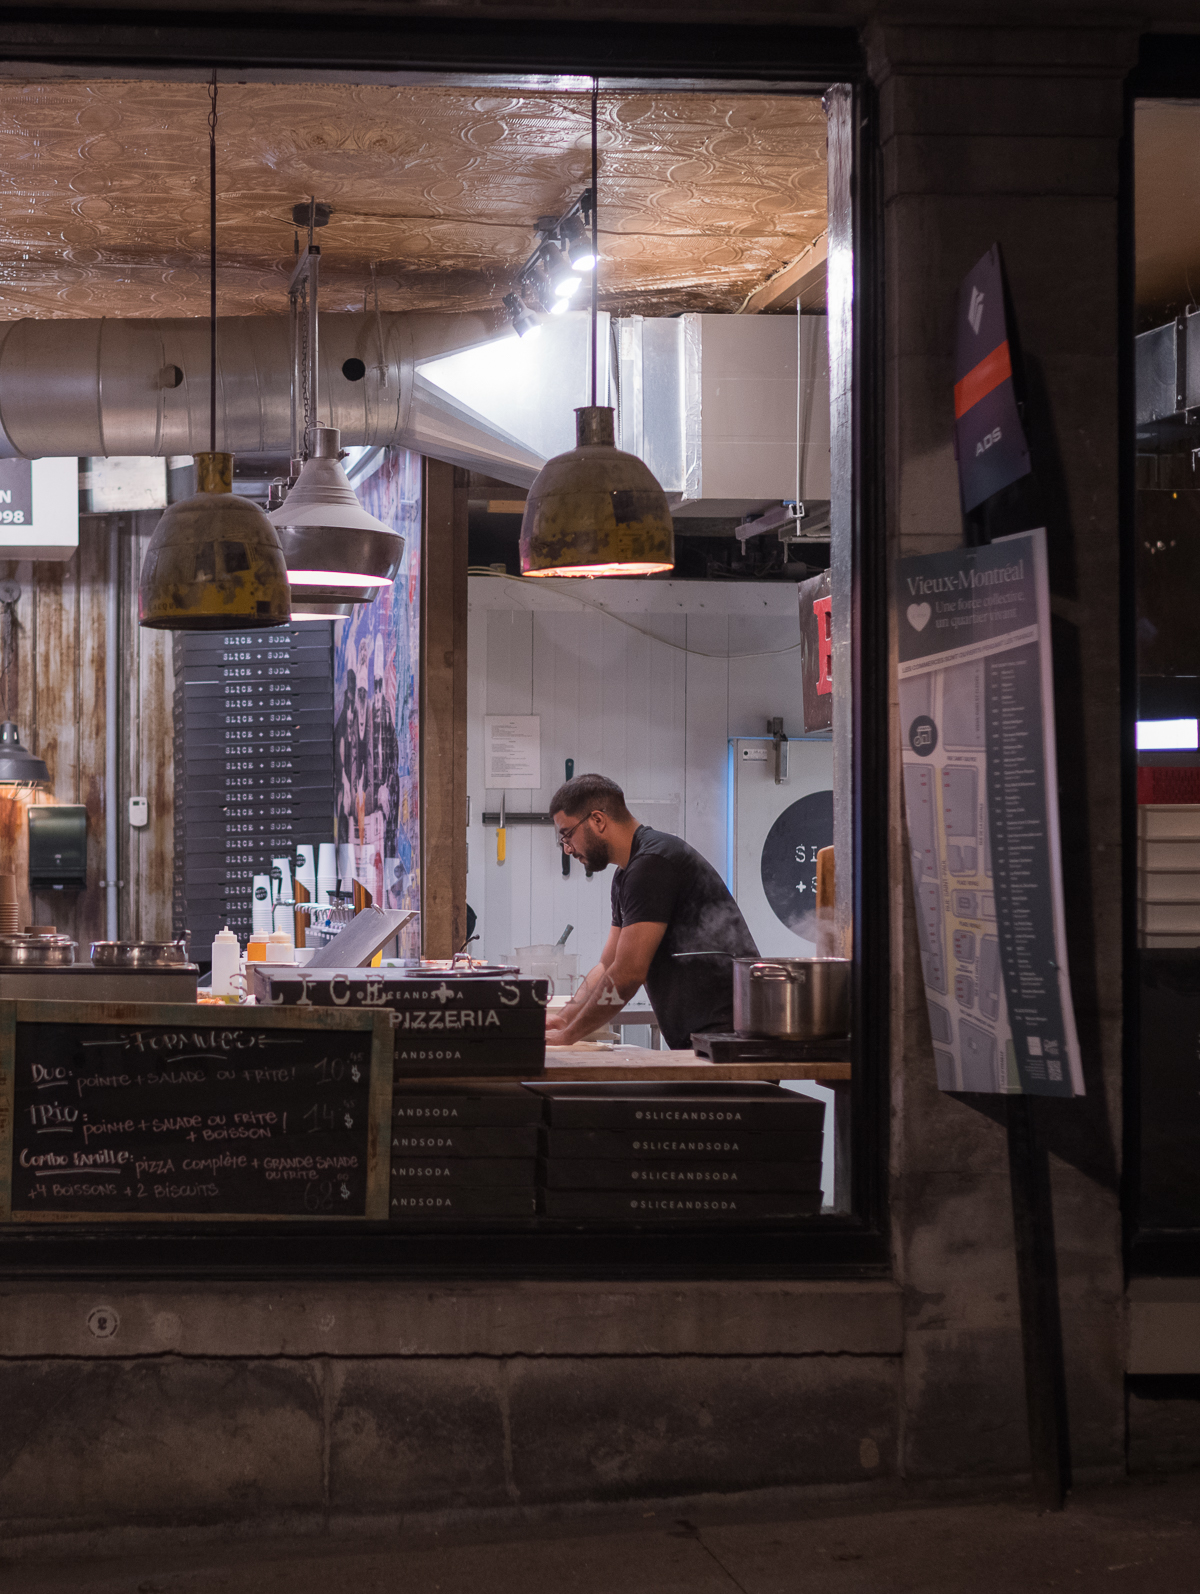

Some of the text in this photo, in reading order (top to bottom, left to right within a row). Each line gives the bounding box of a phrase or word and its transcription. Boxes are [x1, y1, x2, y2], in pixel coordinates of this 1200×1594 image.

[974, 427, 1003, 457] ADS
[907, 559, 1024, 595] Vieux-Montréal
[935, 601, 956, 614] Une
[958, 597, 982, 611] force
[935, 608, 1017, 630] un quartier vivant
[268, 635, 291, 644] SODA
[267, 651, 290, 659] SODA
[913, 658, 943, 670] COMMERCES
[943, 653, 958, 663] SONT
[268, 667, 291, 675] SODA
[269, 684, 292, 692] SODA
[269, 698, 292, 706] SODA
[270, 714, 293, 722] SODA
[270, 745, 292, 753] SODA
[270, 776, 293, 784] SODA
[270, 792, 293, 800] SODA
[270, 807, 293, 815] SODA
[270, 823, 293, 831] SODA
[270, 838, 293, 846] SODA
[389, 1009, 501, 1029] PIZZERIA
[216, 1071, 236, 1082] OU
[207, 1115, 227, 1126] OU
[635, 1110, 742, 1121] @SLICEANDSODA
[203, 1127, 272, 1142] BOISSON
[632, 1141, 739, 1151] @SLICEANDSODA
[630, 1170, 738, 1181] @SLICEANDSODA
[53, 1183, 118, 1197] BOISSONS
[154, 1182, 219, 1198] BISCUITS
[629, 1199, 737, 1210] @SLICEANDSODA
